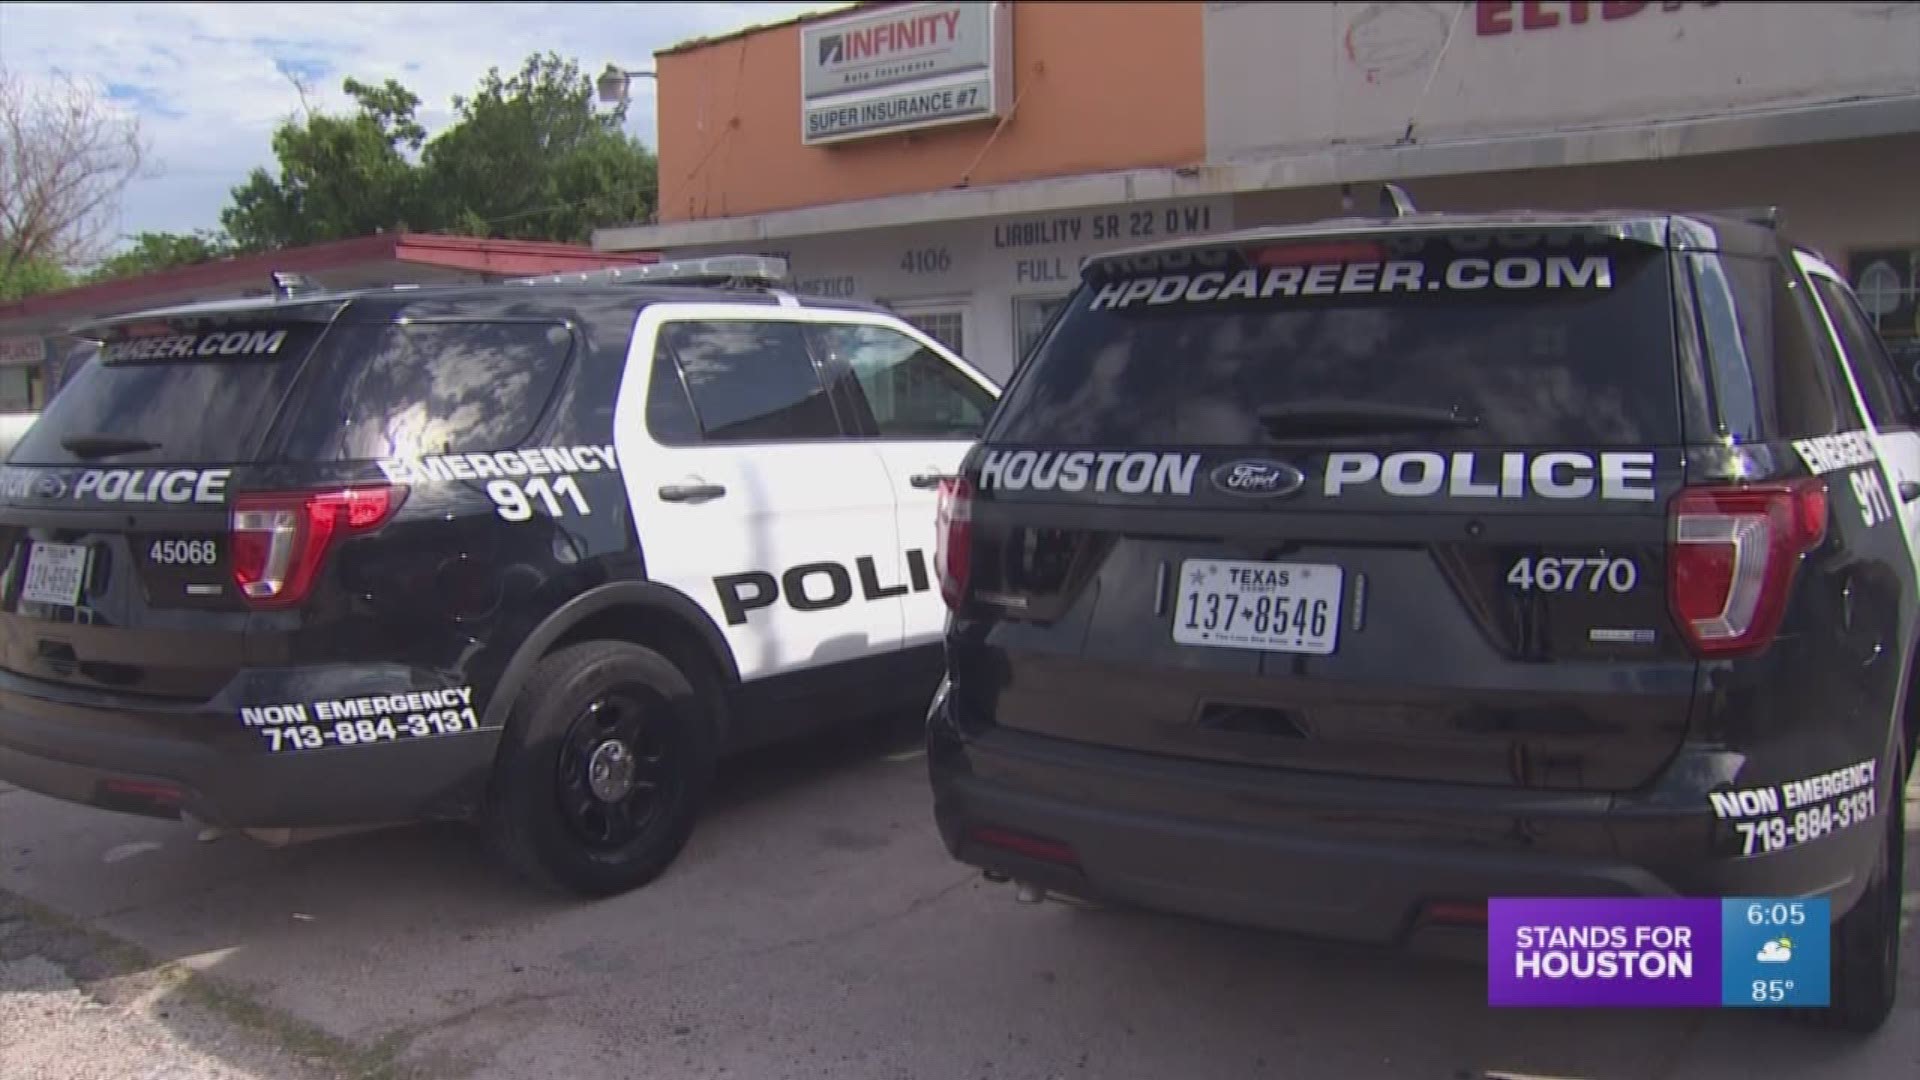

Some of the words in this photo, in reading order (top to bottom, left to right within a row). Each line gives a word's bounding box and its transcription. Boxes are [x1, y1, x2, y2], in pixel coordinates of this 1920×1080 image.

[845, 11, 960, 60] INFINITY
[844, 71, 870, 82] Auto
[875, 60, 935, 78] Insurance
[810, 106, 858, 131] SUPER
[862, 91, 952, 121] INSURANCE
[957, 88, 978, 107] #7
[995, 216, 1081, 248] LIABILITY
[1093, 214, 1120, 240] SR
[1130, 211, 1154, 236] 22
[901, 248, 951, 274] 4106
[1017, 257, 1068, 283] FULL
[1089, 255, 1612, 312] HPDCAREER.COM
[376, 444, 619, 485] EMERGENCY
[1791, 430, 1880, 476] EMERGENC
[74, 468, 232, 503] POLICE
[979, 450, 1200, 495] HOUSTON
[1226, 463, 1279, 490] Ford
[1323, 451, 1656, 501] POLICE
[1848, 466, 1892, 528] 911
[486, 474, 591, 522] 911
[150, 540, 216, 564] 45068
[712, 548, 938, 627] POLI
[1229, 568, 1290, 586] TEXAS
[1507, 557, 1636, 592] 46770
[240, 703, 308, 727] NON
[314, 686, 472, 721] EMERGENCY
[261, 707, 480, 751] 713-884-3131
[1709, 786, 1780, 818] NON
[1782, 758, 1876, 809] EMERGENCY
[1736, 786, 1876, 857] 713-884-3131
